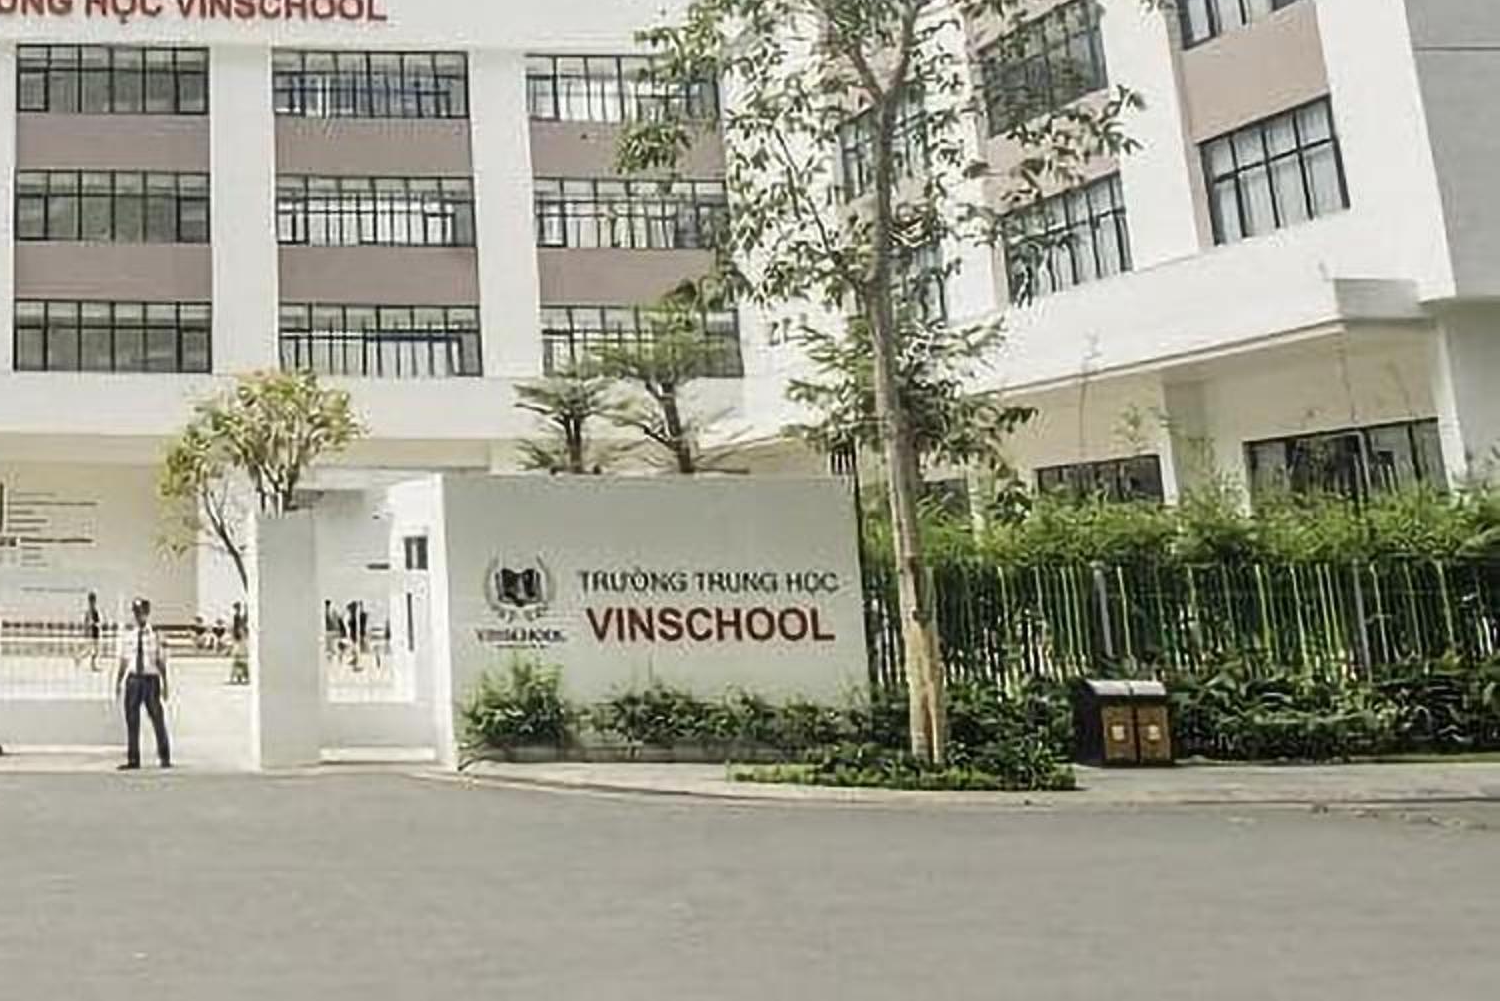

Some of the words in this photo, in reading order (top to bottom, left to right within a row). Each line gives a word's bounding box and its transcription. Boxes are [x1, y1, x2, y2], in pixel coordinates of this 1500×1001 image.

[578, 566, 688, 593] TRƯỜNG
[695, 571, 778, 594] TRUNG
[785, 572, 841, 597] HỌC
[585, 606, 836, 643] VINSCHOOL
